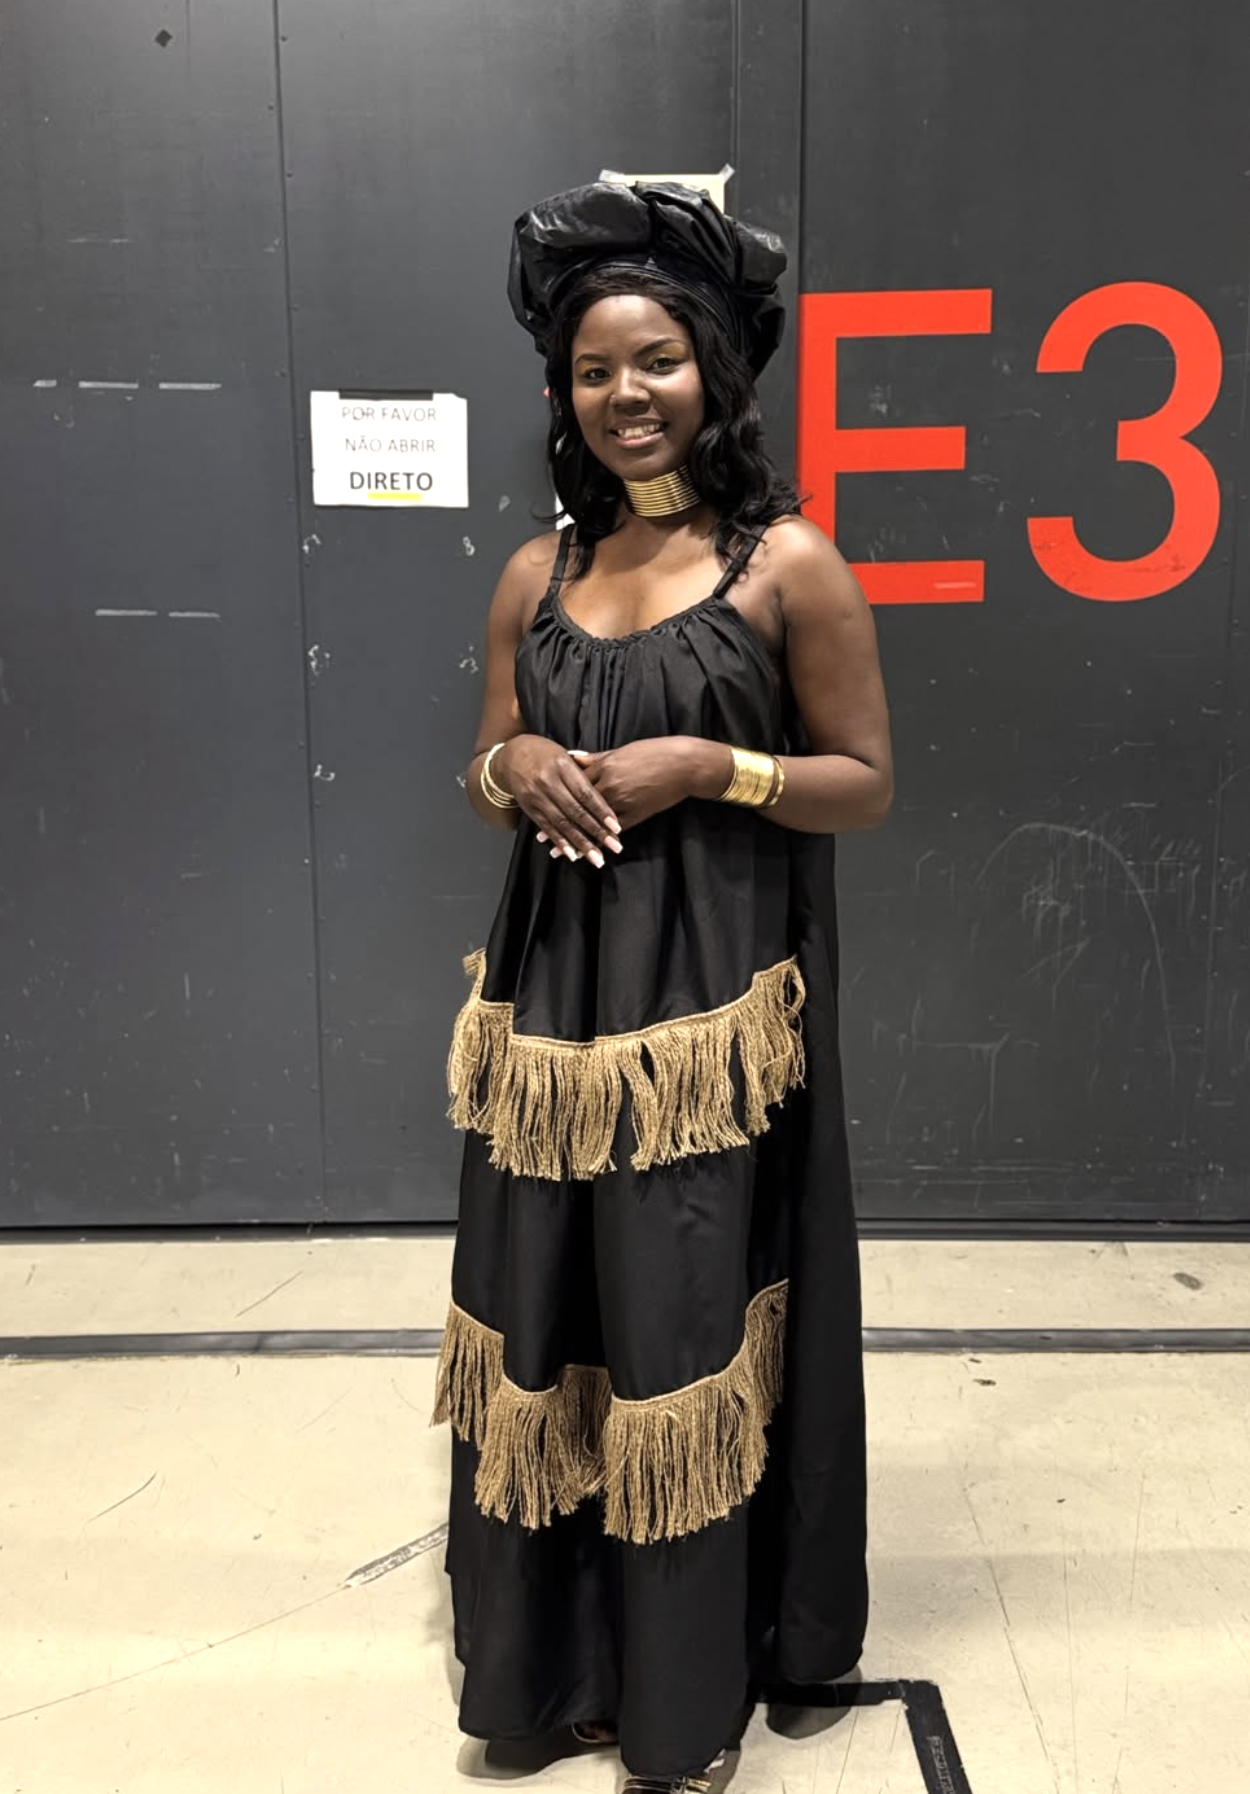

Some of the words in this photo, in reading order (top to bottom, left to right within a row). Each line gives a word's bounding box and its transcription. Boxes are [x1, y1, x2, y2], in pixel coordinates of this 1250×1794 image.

[341, 406, 376, 421] POR
[381, 407, 437, 422] FAVOR
[345, 435, 382, 452] NÃO
[387, 438, 436, 453] ABRIR
[798, 282, 1222, 604] E3
[350, 471, 433, 491] DIRETO
